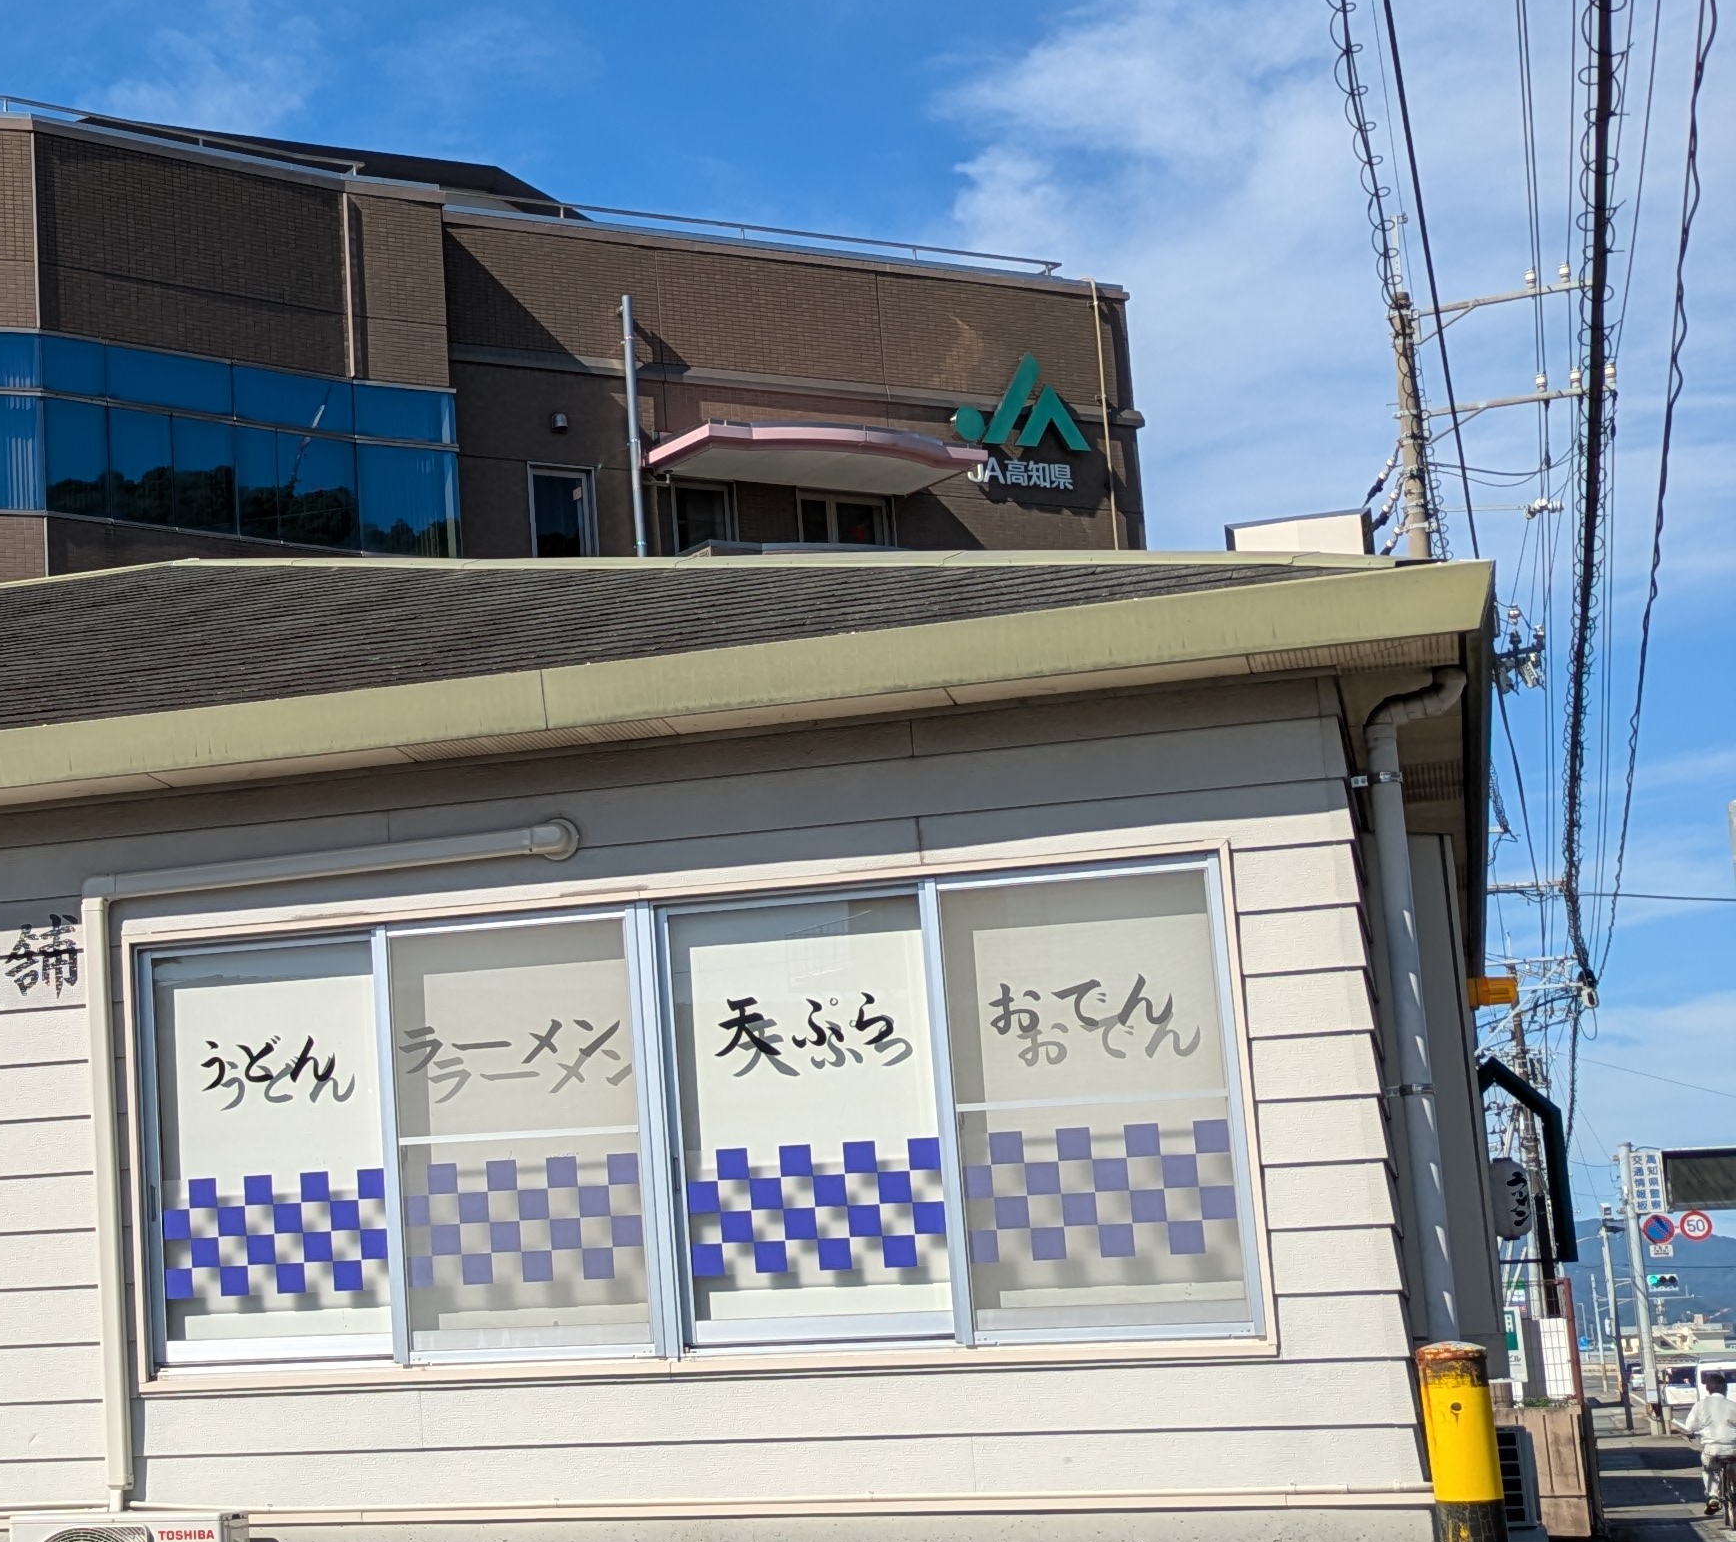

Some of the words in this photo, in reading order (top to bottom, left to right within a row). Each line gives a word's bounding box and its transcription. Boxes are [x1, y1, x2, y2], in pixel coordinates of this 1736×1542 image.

[967, 456, 1074, 491] JA高知県
[714, 991, 894, 1057] 天ぷら
[988, 973, 1173, 1036] おでん
[200, 1035, 337, 1092] うどん
[398, 1018, 621, 1074] ラーメン
[1632, 1155, 1648, 1211] 交通情報板
[1646, 1154, 1662, 1210] 高知県警察
[1686, 1219, 1705, 1233] 50
[157, 1529, 215, 1541] TOSHIBA
